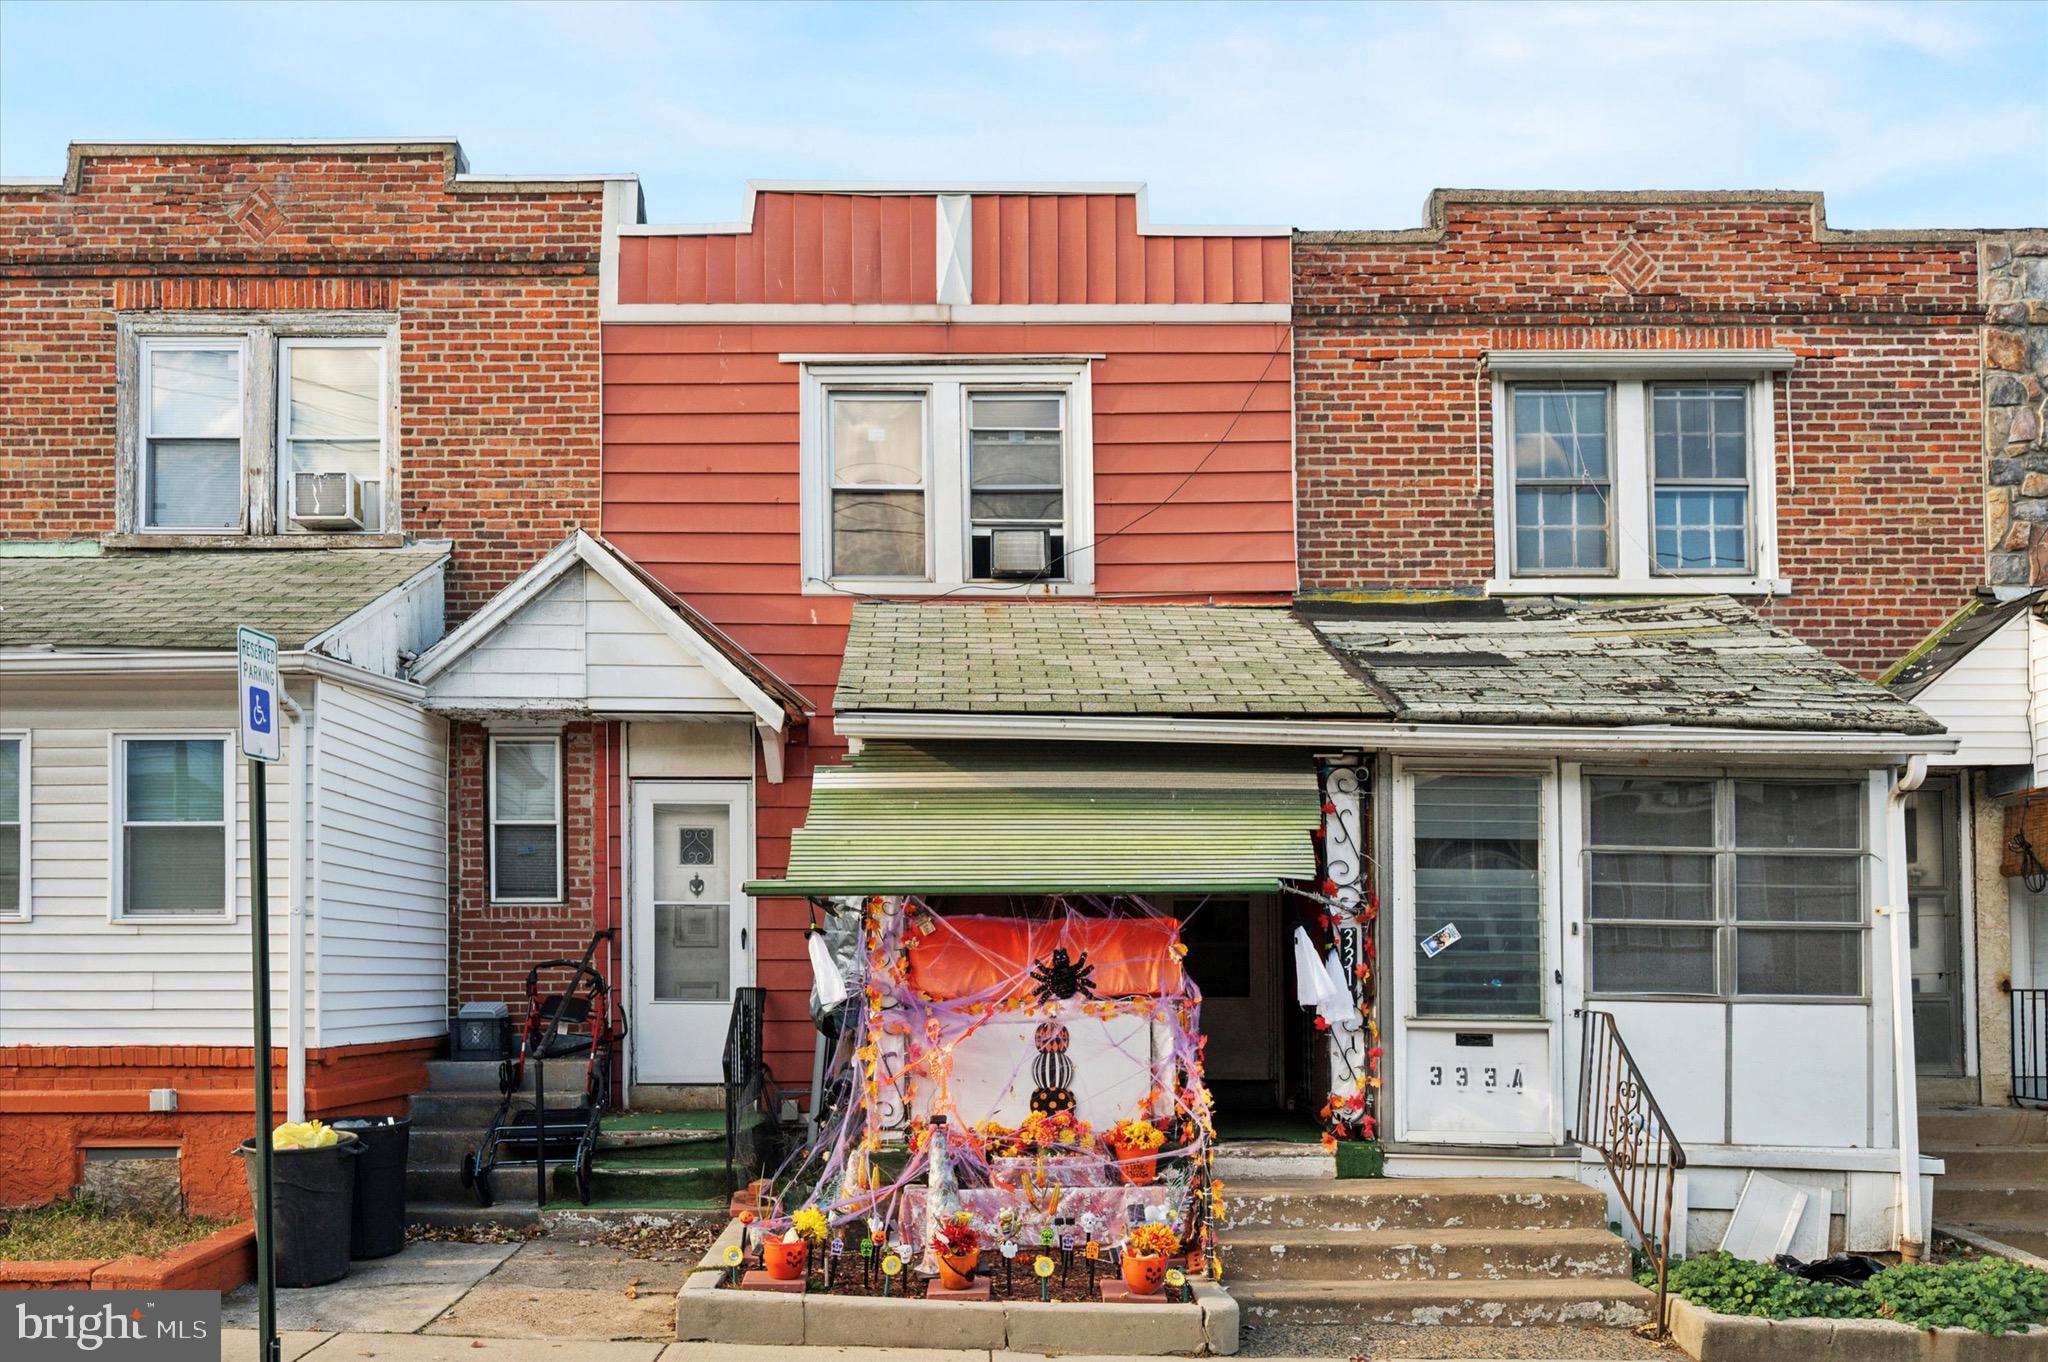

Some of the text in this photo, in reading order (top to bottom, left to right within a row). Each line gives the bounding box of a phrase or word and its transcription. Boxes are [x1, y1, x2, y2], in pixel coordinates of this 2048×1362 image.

[241, 639, 275, 665] RESERVED
[243, 661, 275, 686] PARKING
[1343, 928, 1354, 986] 331
